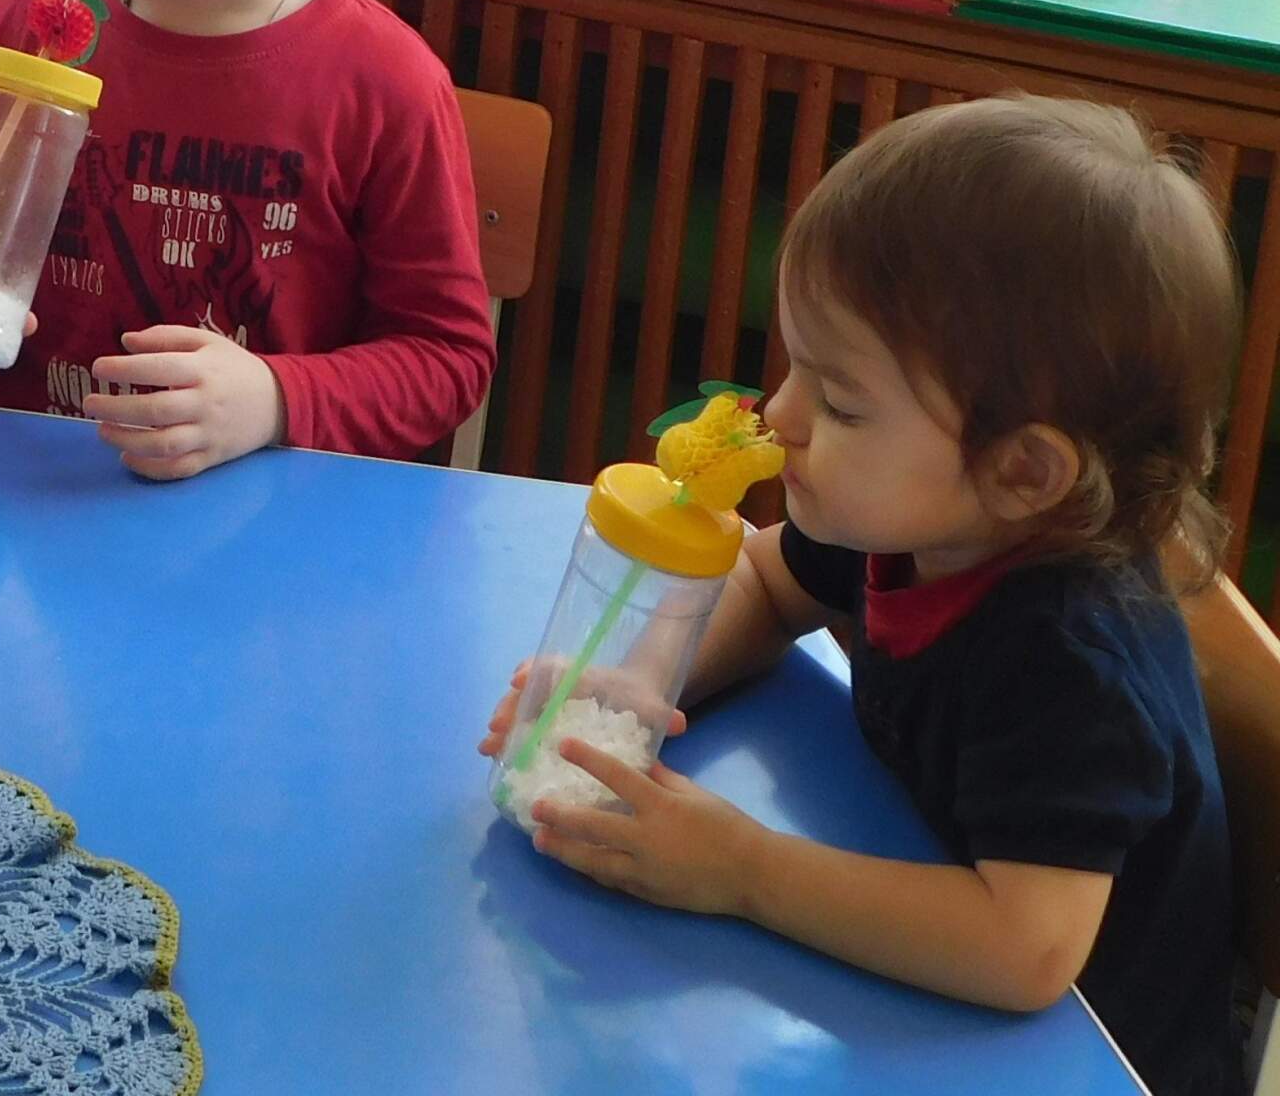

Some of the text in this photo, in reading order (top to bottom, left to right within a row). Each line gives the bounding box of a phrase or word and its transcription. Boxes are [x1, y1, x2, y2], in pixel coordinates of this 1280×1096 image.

[123, 129, 305, 198] FLAMES
[131, 184, 224, 212] DRUMS
[161, 207, 228, 245] STICKS
[262, 202, 298, 231] 96
[162, 238, 195, 269] OK
[260, 240, 293, 260] YES
[50, 253, 105, 297] LYRICS
